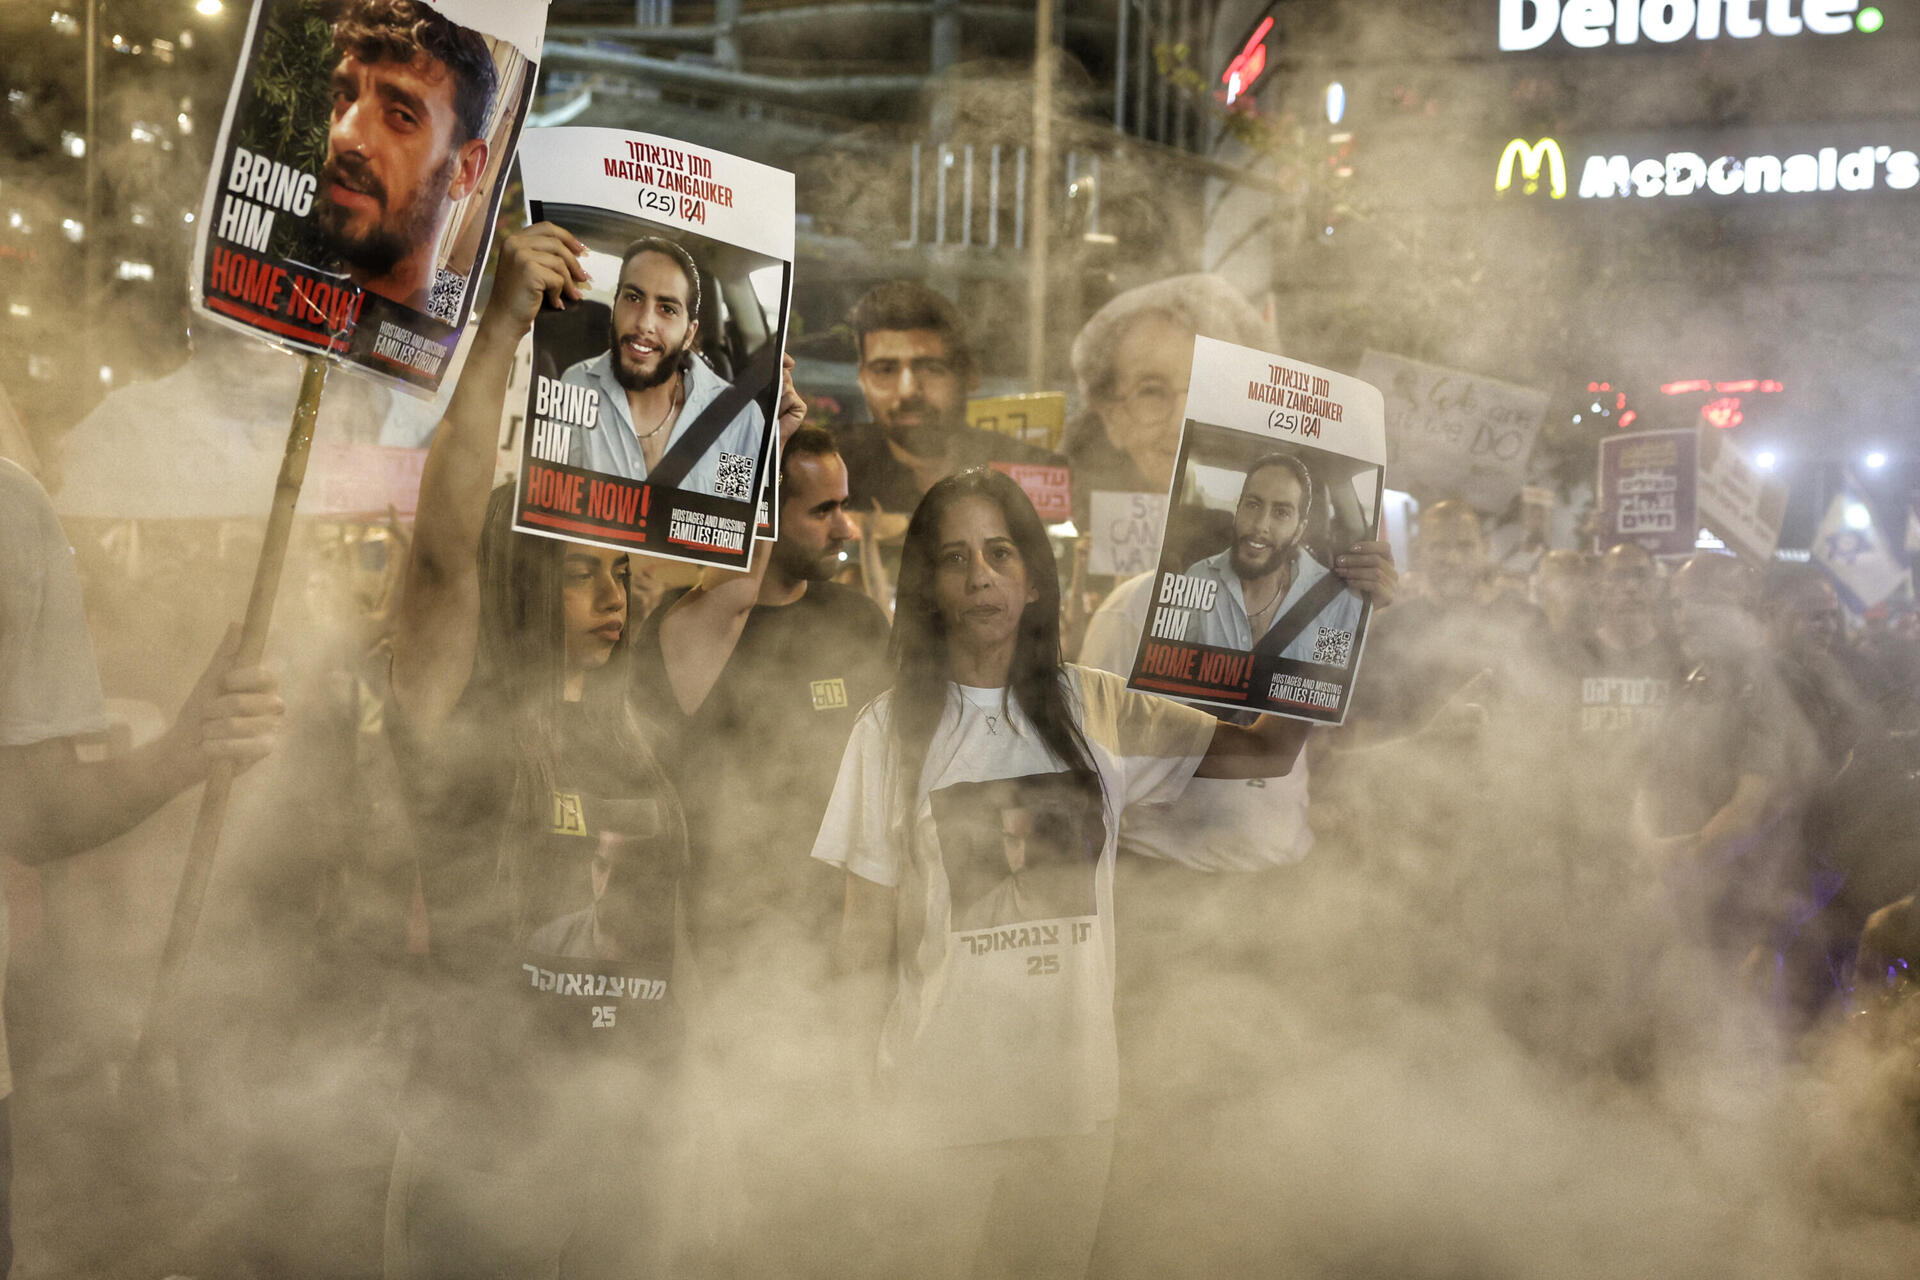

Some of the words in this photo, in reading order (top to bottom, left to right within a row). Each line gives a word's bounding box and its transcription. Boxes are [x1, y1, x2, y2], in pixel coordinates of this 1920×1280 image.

[625, 140, 684, 170] צנגאוקר
[687, 155, 712, 179] מתן
[228, 147, 317, 217] BRING
[604, 158, 653, 185] MATAN
[658, 168, 733, 208] ZANGAUKER
[1579, 146, 1919, 198] McDonald's
[638, 188, 676, 216] (25)
[217, 195, 276, 253] HIM
[211, 246, 287, 311] HOME
[287, 275, 366, 336] NOW!
[380, 320, 412, 345] HOSTAGES
[411, 331, 425, 348] AND
[373, 335, 413, 367] FAMILIES
[412, 351, 442, 376] FORUM
[1269, 364, 1309, 391] צנגאוקר
[1311, 376, 1330, 398] מתן
[535, 375, 599, 429] BRING
[1248, 381, 1285, 408] MATAN
[1287, 390, 1343, 423] ZANGAUKER
[1268, 410, 1298, 434] (25)
[531, 419, 572, 465] HIM
[526, 465, 584, 515] HOME
[589, 480, 650, 527] NOW!
[669, 520, 711, 545] FAMILIES
[711, 530, 744, 551] FORUM
[672, 508, 704, 526] HOSTAGES
[704, 514, 718, 528] AND
[718, 516, 746, 532] MISSING
[1159, 572, 1217, 611] BRING
[1150, 606, 1190, 641] HIM
[1141, 642, 1198, 680] HOME
[1197, 652, 1255, 688] NOW!
[1268, 683, 1307, 703] FAMILIES
[1307, 692, 1340, 709] FORUM
[1272, 673, 1301, 688] HOSTAGES
[1301, 678, 1315, 690] AND
[1315, 680, 1343, 695] MISSING
[961, 925, 1059, 956] צנגאוקר
[1071, 922, 1092, 946] תן
[1027, 954, 1060, 976] 25
[592, 1006, 617, 1028] 25
